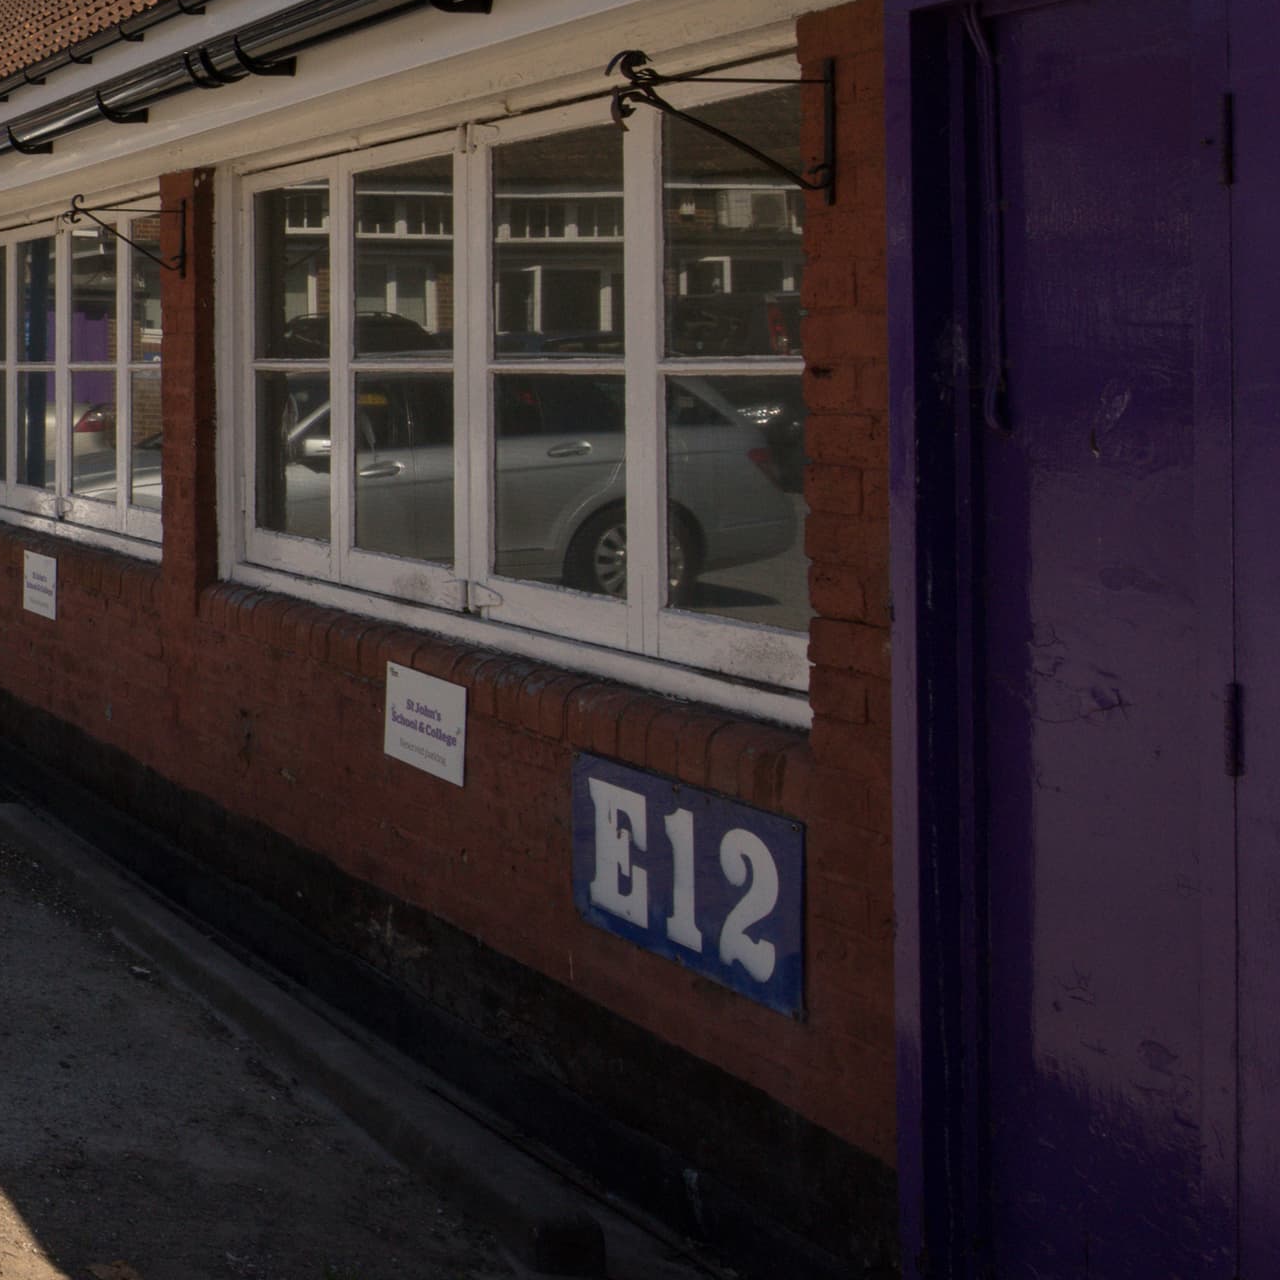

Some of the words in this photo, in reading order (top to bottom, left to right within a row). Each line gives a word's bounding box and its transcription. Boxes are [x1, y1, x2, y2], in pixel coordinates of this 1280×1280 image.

[406, 698, 415, 712] St
[415, 702, 442, 723] John's
[391, 711, 418, 731] School
[418, 722, 425, 733] &
[425, 724, 457, 747] College
[588, 777, 779, 983] E12
